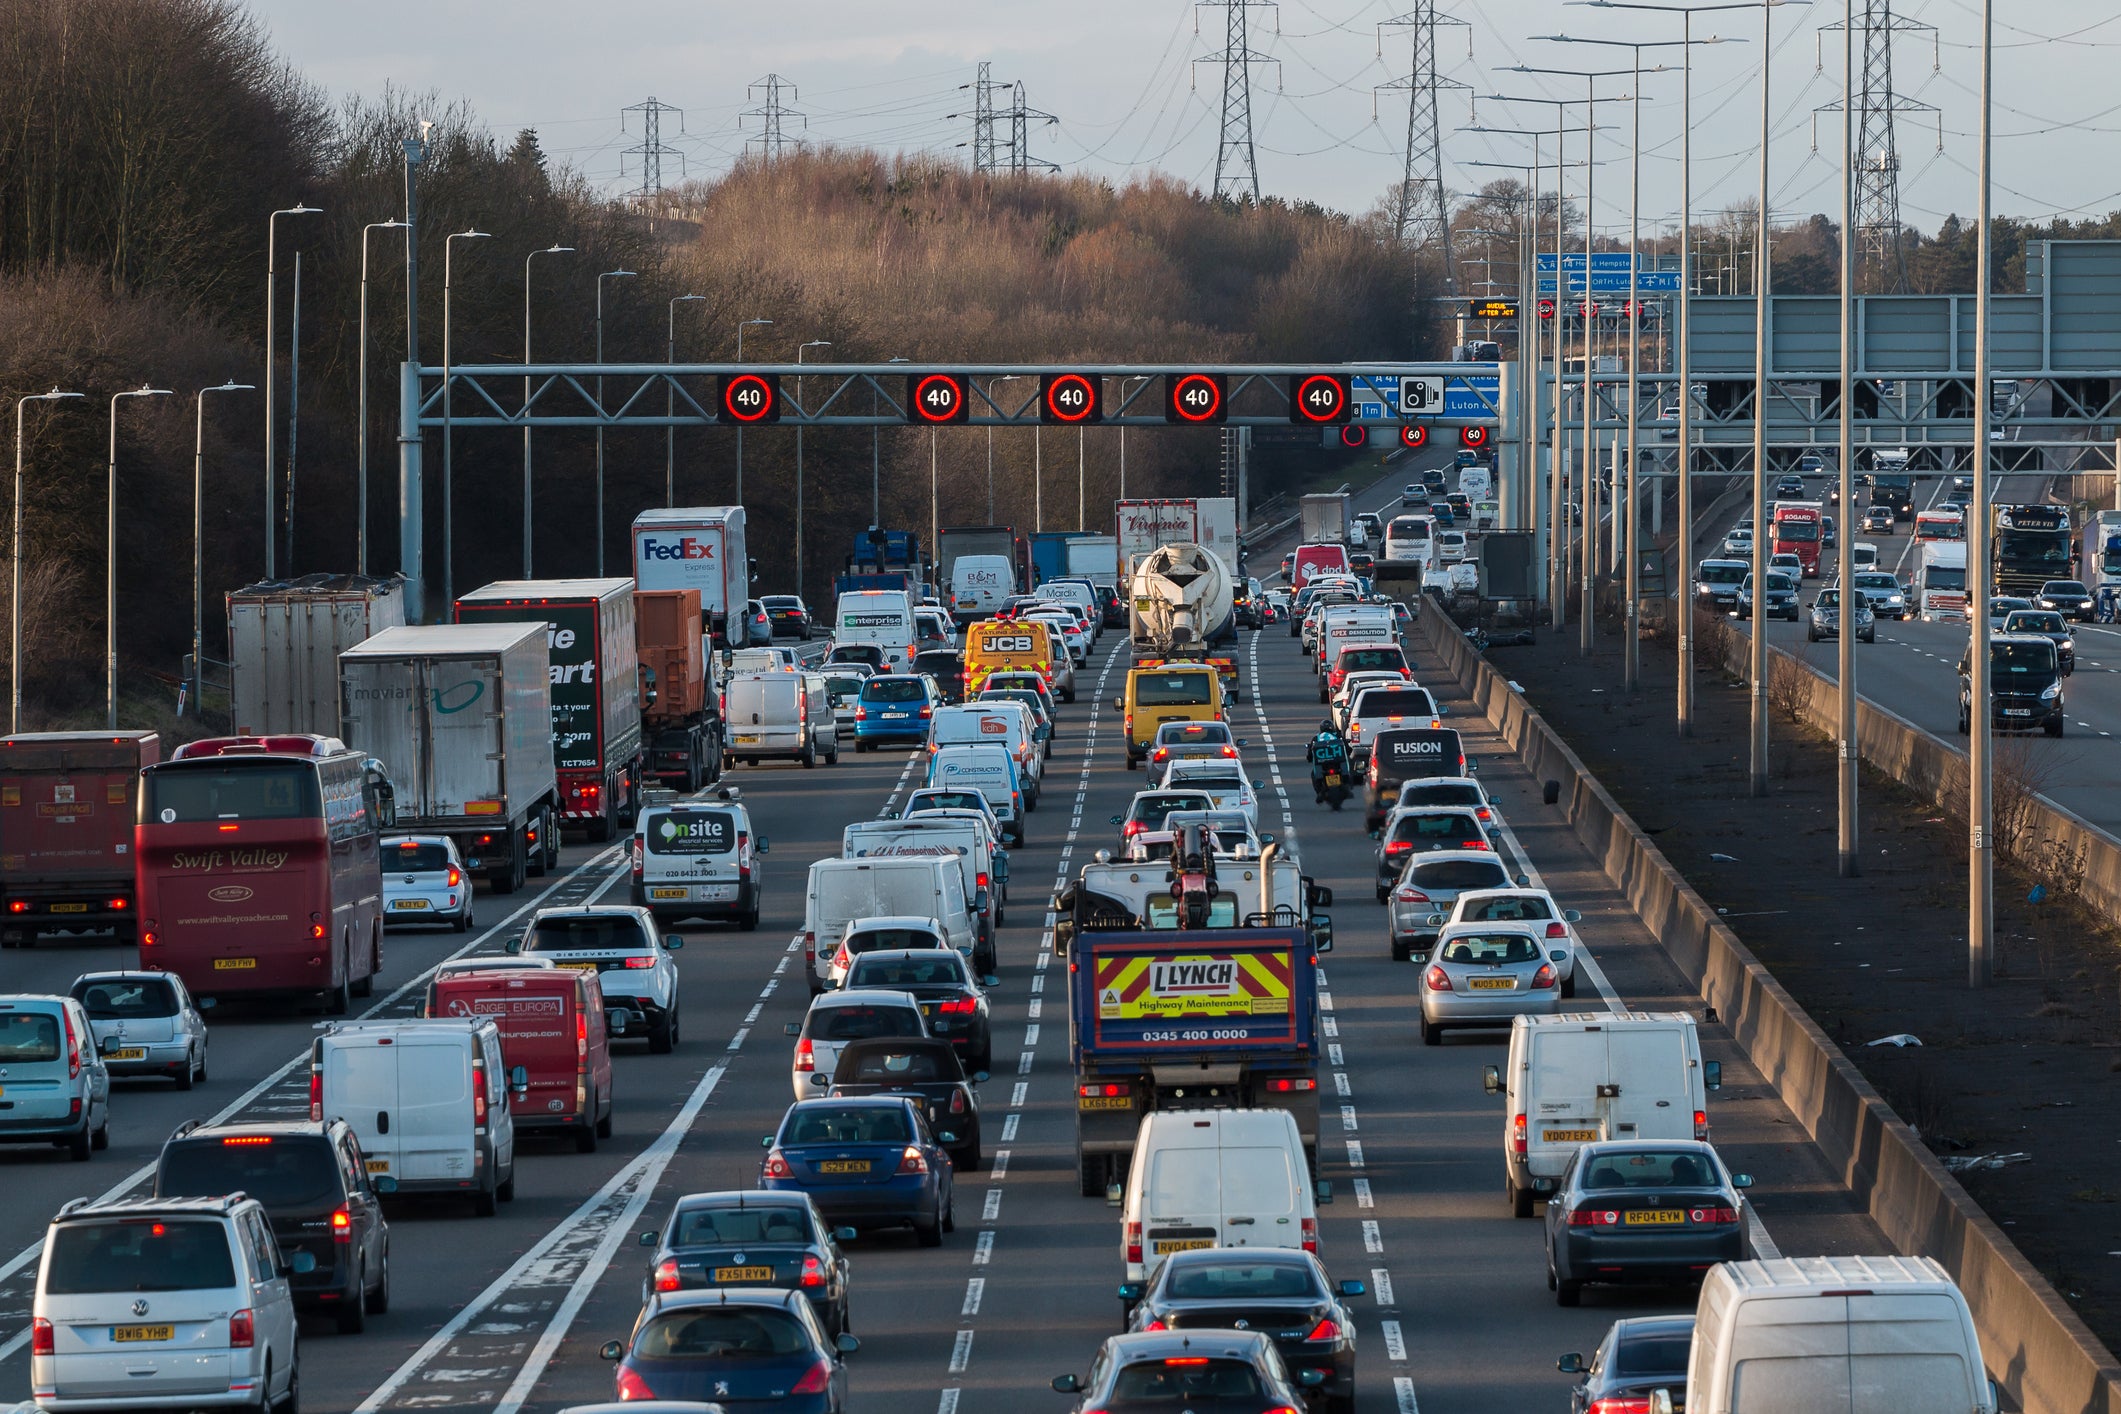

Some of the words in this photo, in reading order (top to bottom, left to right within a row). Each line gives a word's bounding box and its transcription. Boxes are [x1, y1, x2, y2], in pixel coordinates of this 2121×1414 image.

[1478, 309, 1501, 317] AFTER
[1501, 309, 1515, 317] JCT
[738, 390, 760, 405] 40
[928, 390, 951, 405] 40
[1060, 390, 1083, 405] 40
[1186, 390, 1209, 405] 40
[1310, 390, 1333, 405] 40
[1451, 402, 1480, 410] Luton
[1407, 430, 1420, 440] 60
[1468, 429, 1480, 439] 60
[1125, 515, 1190, 535] Virginia
[643, 537, 715, 561] FedEx
[684, 562, 716, 573] Express
[1321, 564, 1343, 575] dpd
[967, 570, 997, 581] B&M
[1045, 588, 1078, 598] Mardix
[845, 616, 903, 627] enterprise
[1331, 629, 1348, 637] APEX
[983, 636, 1033, 652] JCB
[570, 704, 591, 712] your
[981, 723, 999, 733] kdh
[1315, 745, 1343, 760] GLH
[1393, 741, 1442, 754] FUSION
[561, 759, 596, 767] TCT7654
[172, 852, 224, 872] Swift
[231, 849, 289, 869] Valley
[177, 913, 289, 925] www.swiftvalleycoaches.com
[555, 950, 618, 958] DISCOVERY
[474, 1002, 509, 1014] ENGEL
[513, 1001, 558, 1013] EUROPA
[1138, 999, 1183, 1011] Highway
[1185, 998, 1250, 1010] Maintenance
[1142, 1031, 1178, 1042] 0345
[1182, 1030, 1209, 1040] 400
[1212, 1029, 1248, 1039] 0000
[550, 1101, 562, 1110] GB
[1546, 1132, 1570, 1141] YD07
[1572, 1131, 1592, 1140] EFX
[1628, 1211, 1657, 1223] RF04
[718, 1268, 743, 1280] FX51
[116, 1327, 143, 1340] BW16
[146, 1326, 168, 1339] YHR
